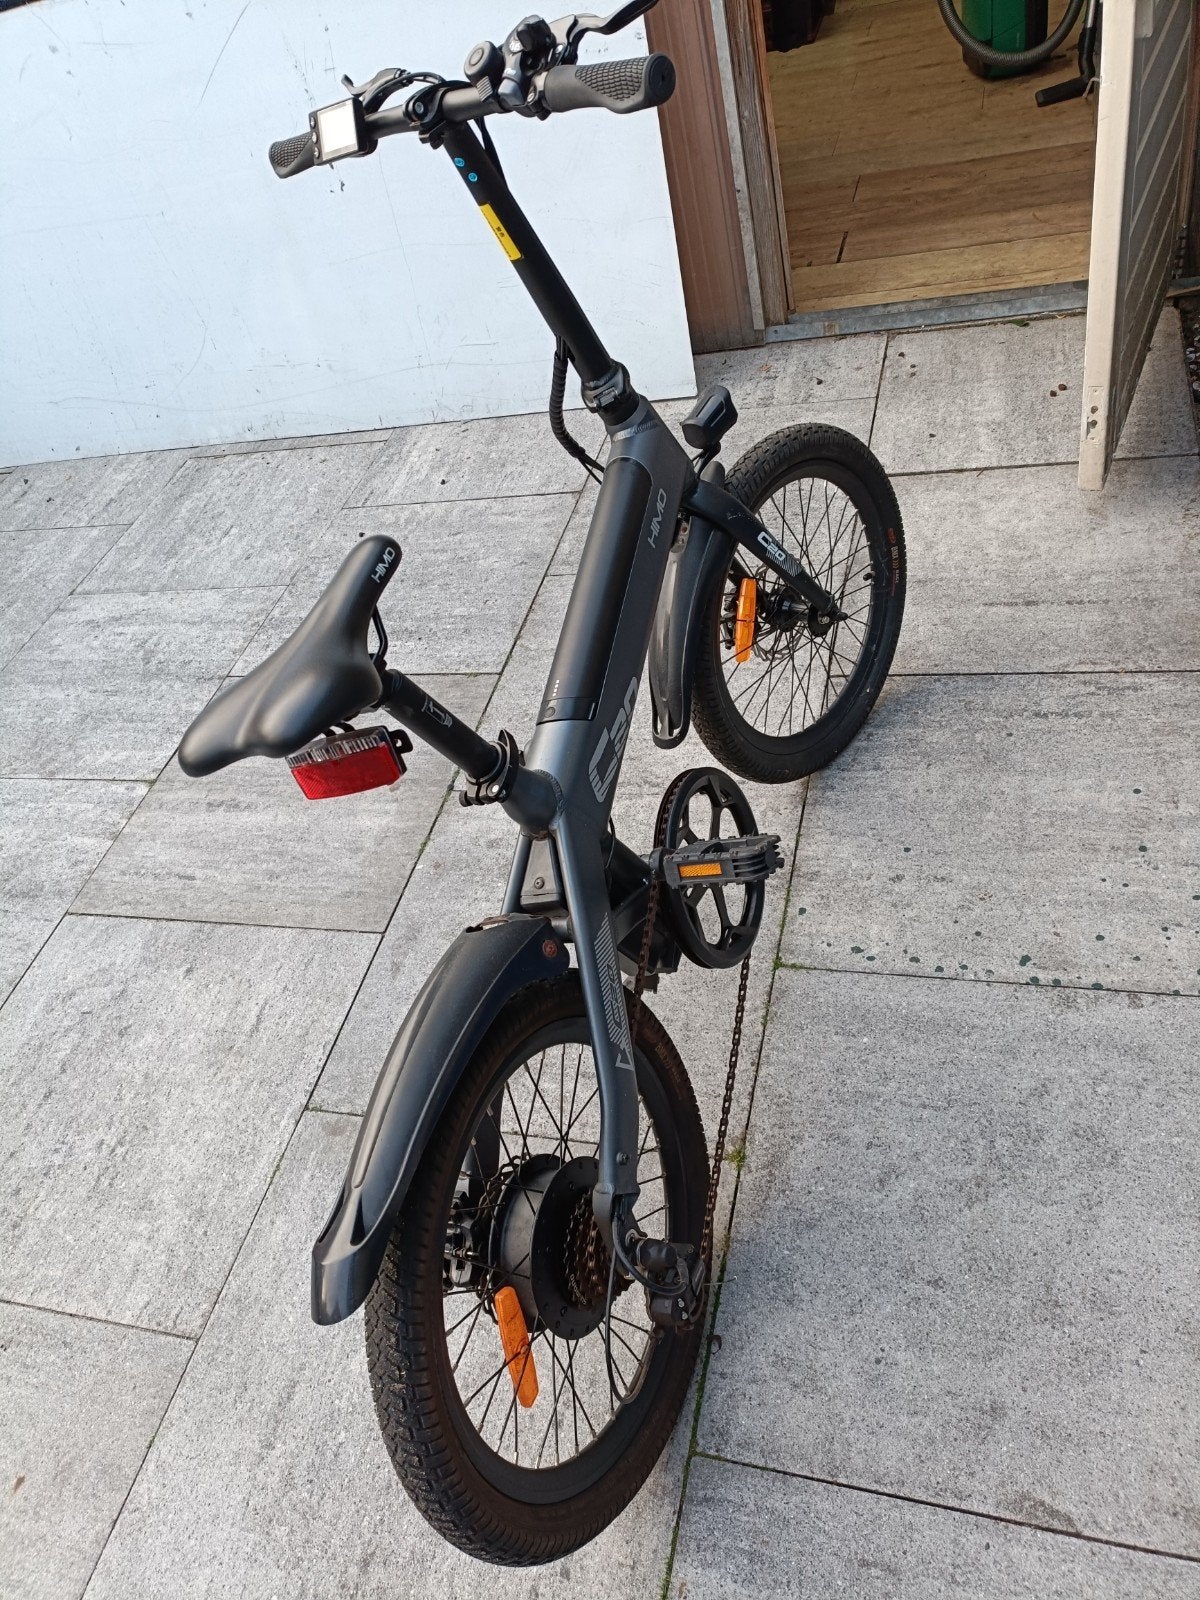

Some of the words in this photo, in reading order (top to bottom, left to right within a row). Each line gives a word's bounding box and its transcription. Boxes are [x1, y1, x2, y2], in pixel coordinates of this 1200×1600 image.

[647, 488, 667, 549] HIMO
[757, 531, 786, 561] C20
[371, 547, 396, 583] HIMO
